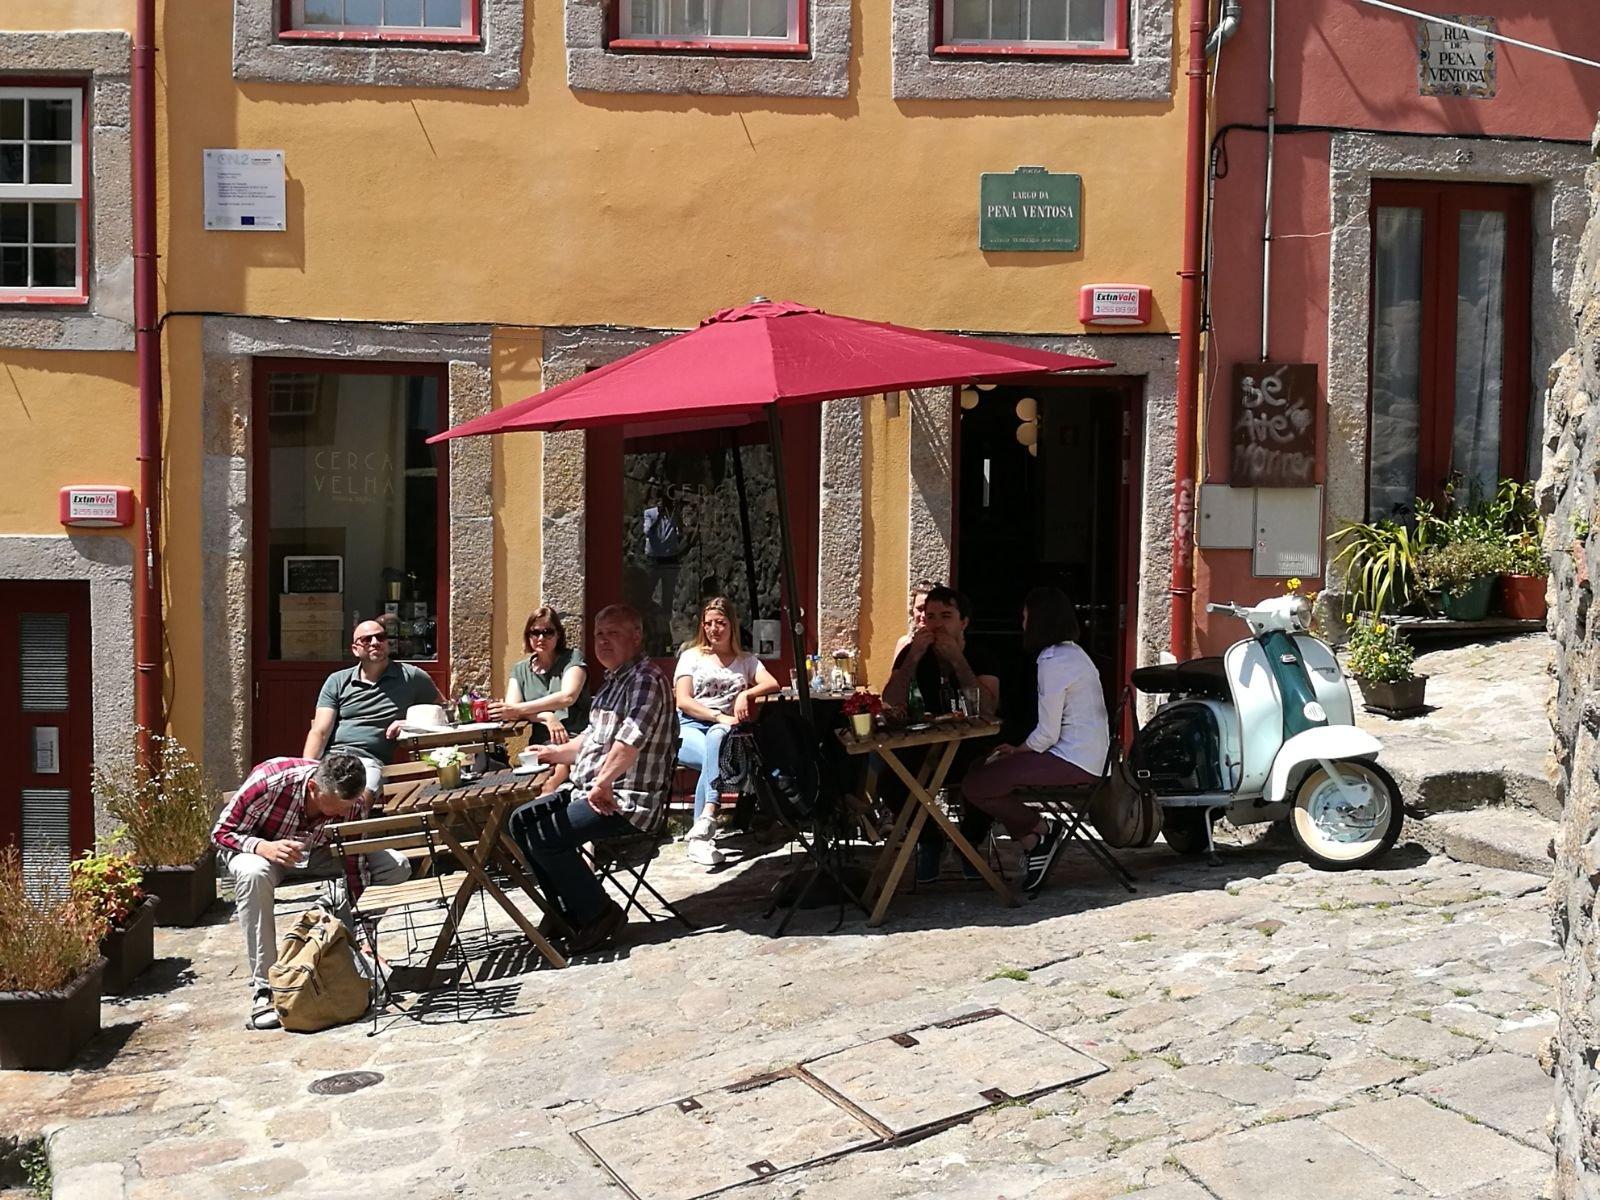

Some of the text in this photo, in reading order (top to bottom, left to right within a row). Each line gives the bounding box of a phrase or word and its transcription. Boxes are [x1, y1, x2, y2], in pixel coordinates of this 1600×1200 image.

[1444, 27, 1470, 41] RUA
[1438, 52, 1476, 66] PENA
[1430, 68, 1486, 83] VENTOSA
[1012, 191, 1049, 200] LARGO DA
[987, 205, 1074, 218] PENA VENTOSA
[1097, 293, 1137, 302] ExtinVale
[314, 451, 393, 471] CERCA
[313, 475, 394, 495] VELHA
[73, 495, 114, 504] ExtinVale
